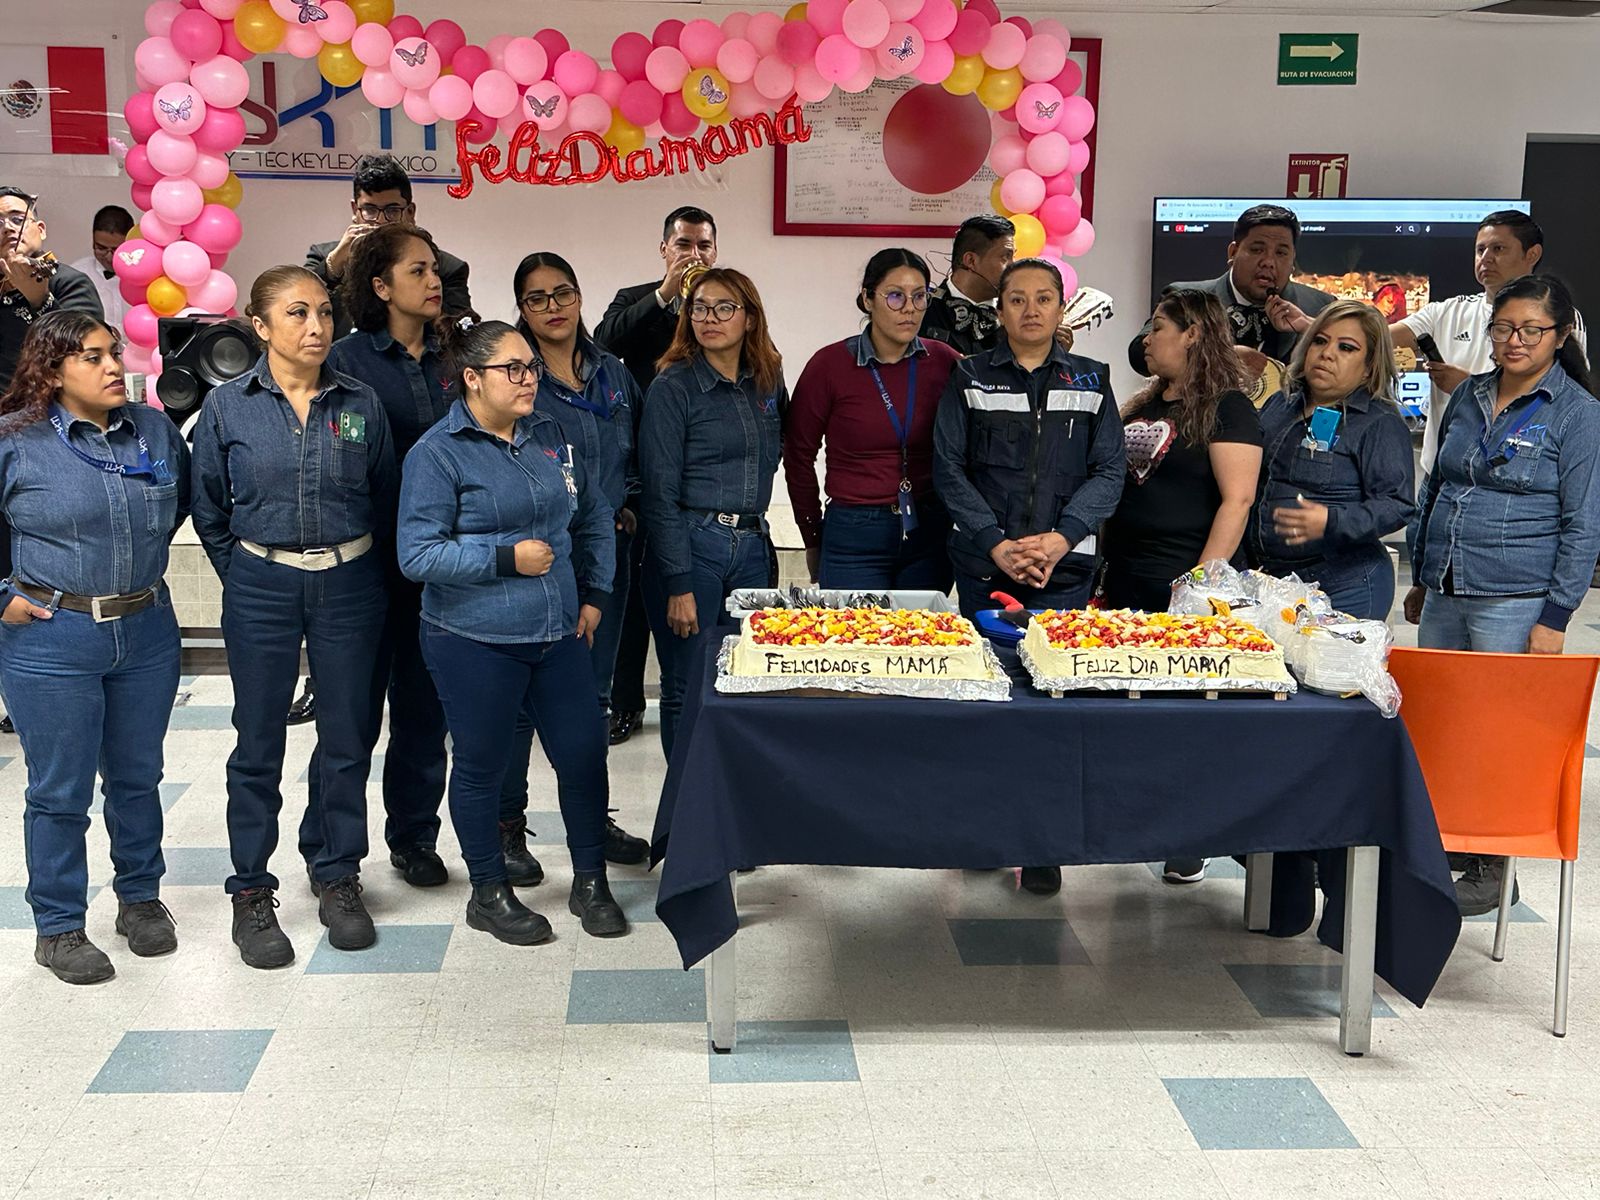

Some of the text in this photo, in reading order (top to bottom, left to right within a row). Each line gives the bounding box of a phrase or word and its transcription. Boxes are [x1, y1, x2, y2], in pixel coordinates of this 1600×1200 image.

[255, 151, 289, 168] TEC
[292, 152, 363, 171] KEYLEX
[392, 155, 437, 172] XICO
[764, 652, 872, 675] FELICIDADES
[1071, 653, 1124, 677] FELIZ
[1127, 654, 1159, 675] DIA
